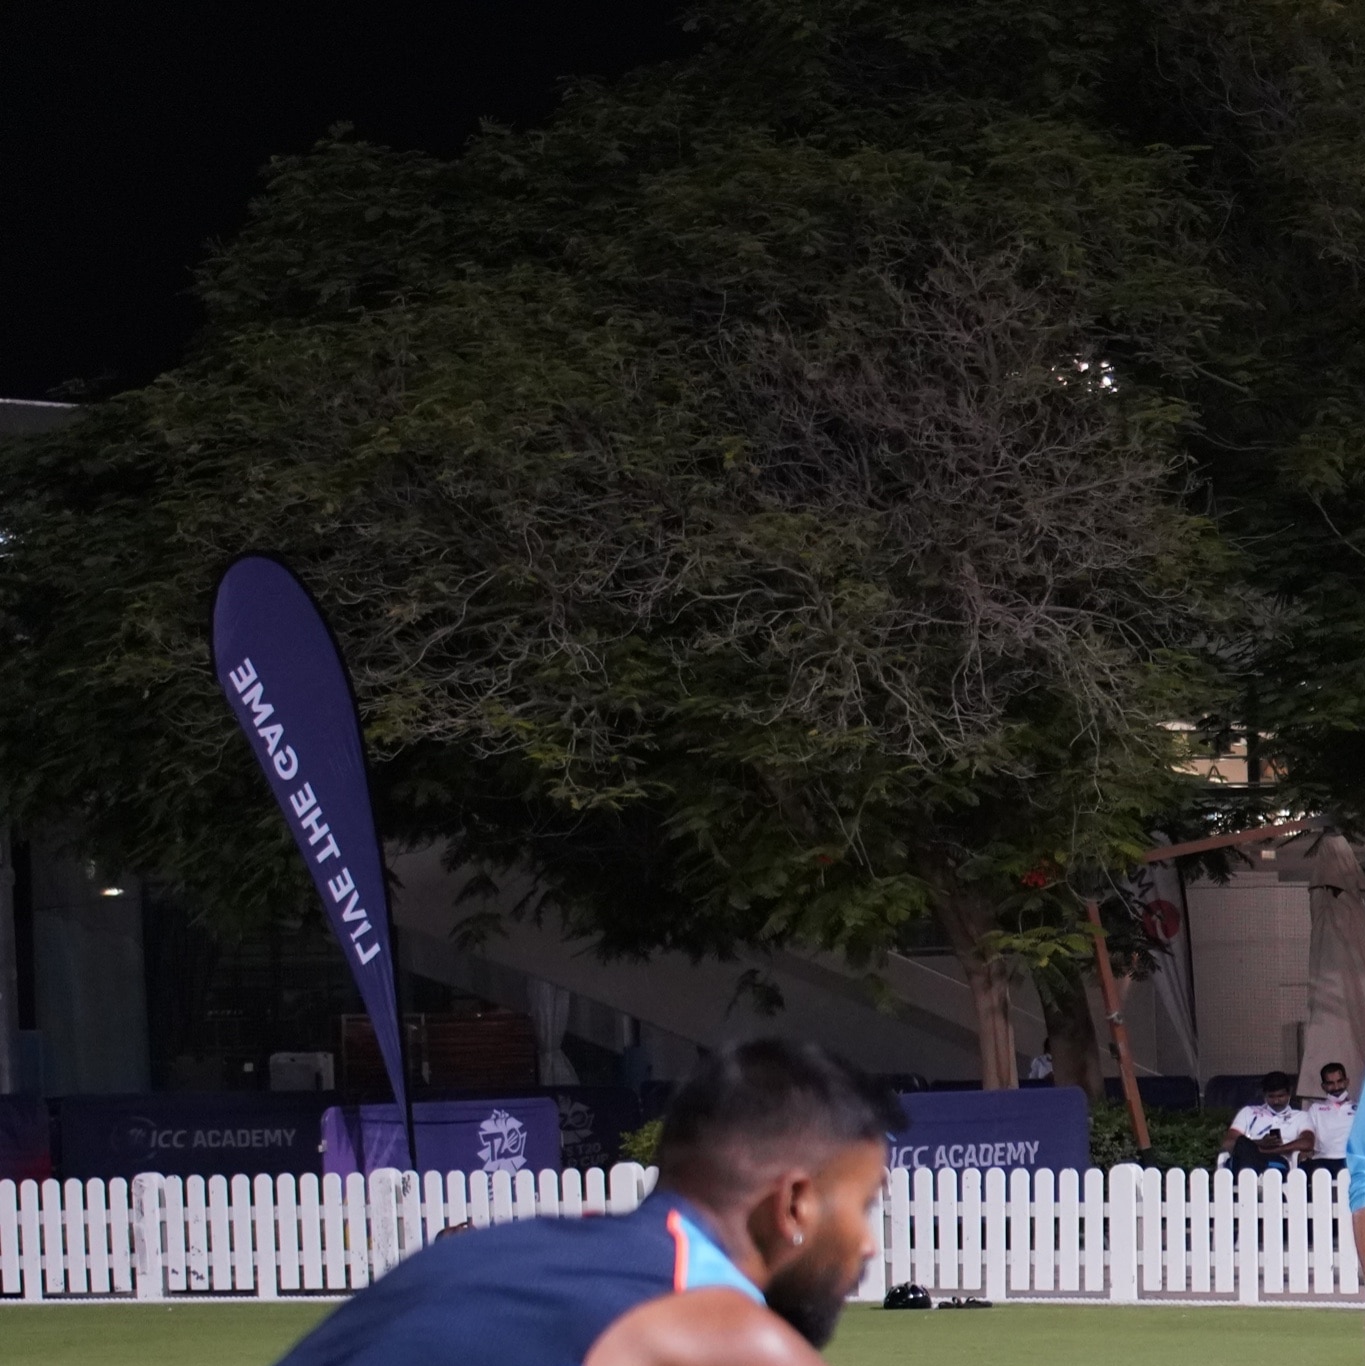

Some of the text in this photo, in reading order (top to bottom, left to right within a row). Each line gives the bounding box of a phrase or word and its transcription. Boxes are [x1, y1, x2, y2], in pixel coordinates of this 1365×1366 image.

[149, 1128, 297, 1149] ICC ACADEMY
[889, 1140, 1041, 1170] ICC ACADEMY
